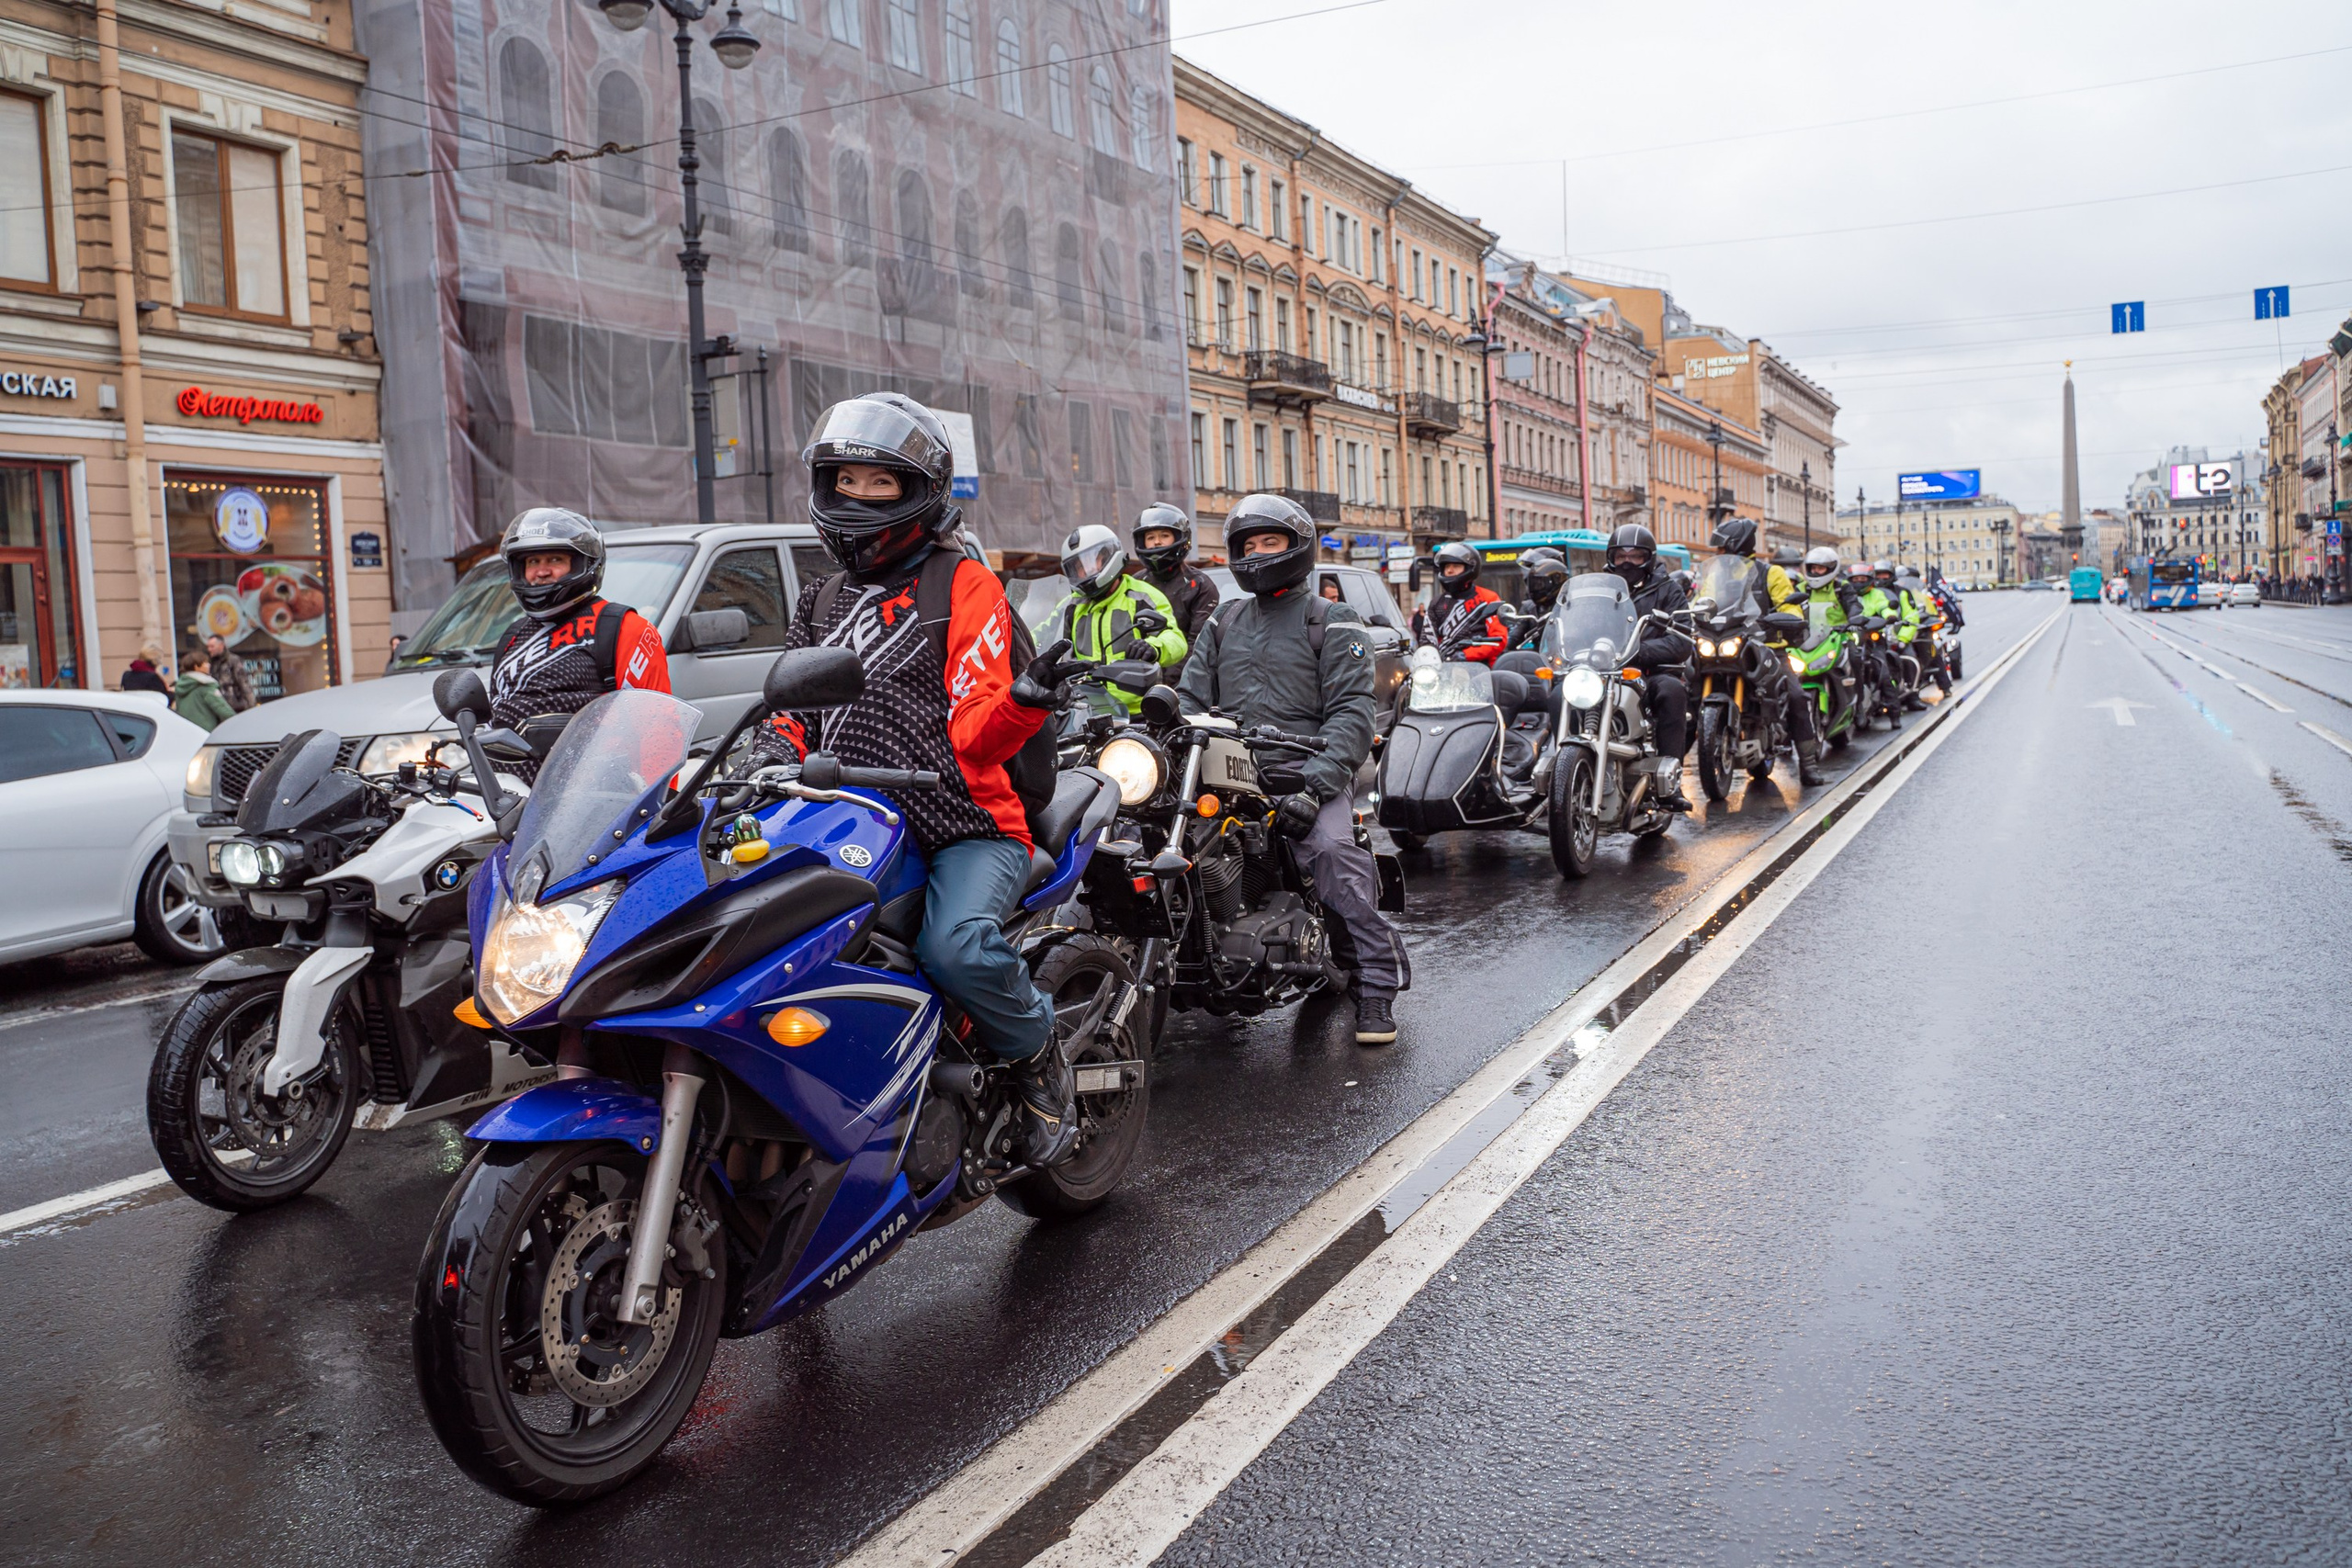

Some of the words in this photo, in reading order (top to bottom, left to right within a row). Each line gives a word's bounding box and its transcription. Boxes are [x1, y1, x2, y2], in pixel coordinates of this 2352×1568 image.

[1707, 354, 1749, 367] НЕВСКИЙ
[0, 371, 77, 400] СКАЯ
[177, 386, 324, 424] Метрополь
[833, 446, 877, 458] SHARK
[522, 527, 545, 536] SHOEI
[460, 1088, 493, 1106] BMW
[822, 1213, 909, 1290] YAMAHA
